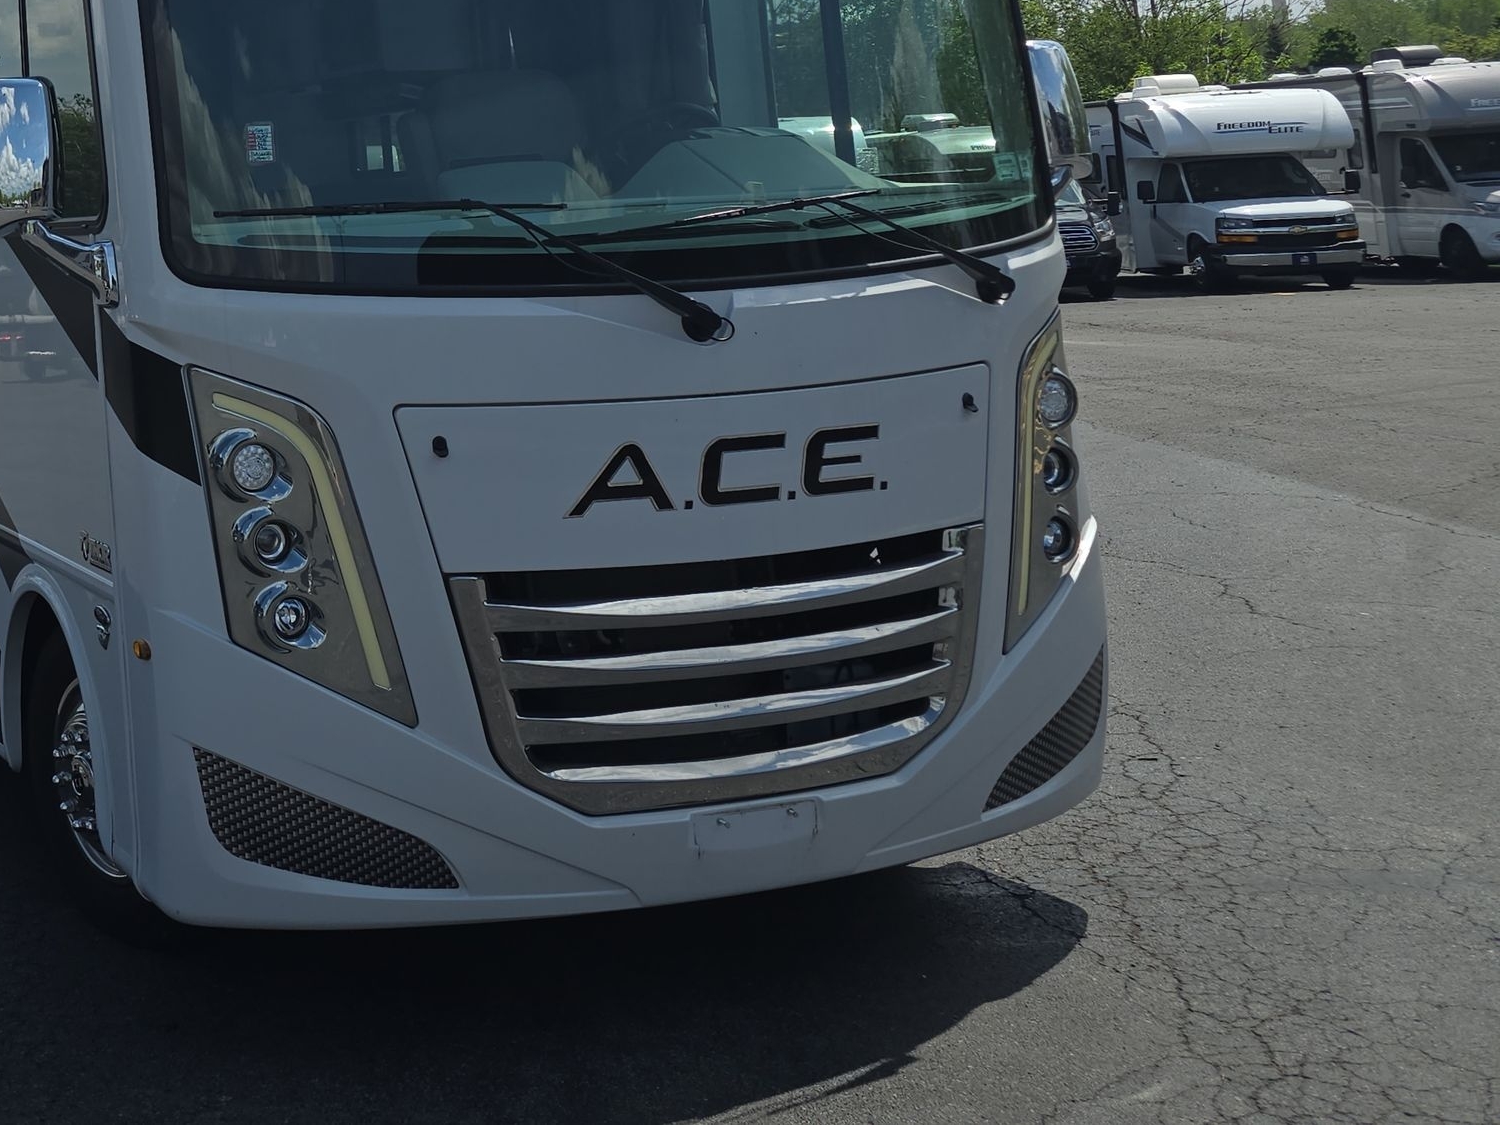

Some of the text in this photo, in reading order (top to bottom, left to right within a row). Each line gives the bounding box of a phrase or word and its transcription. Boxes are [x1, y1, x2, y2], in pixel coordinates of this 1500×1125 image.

[1216, 120, 1271, 131] FREEDOM
[1268, 126, 1304, 134] ELITE
[563, 423, 888, 519] A.C.E.
